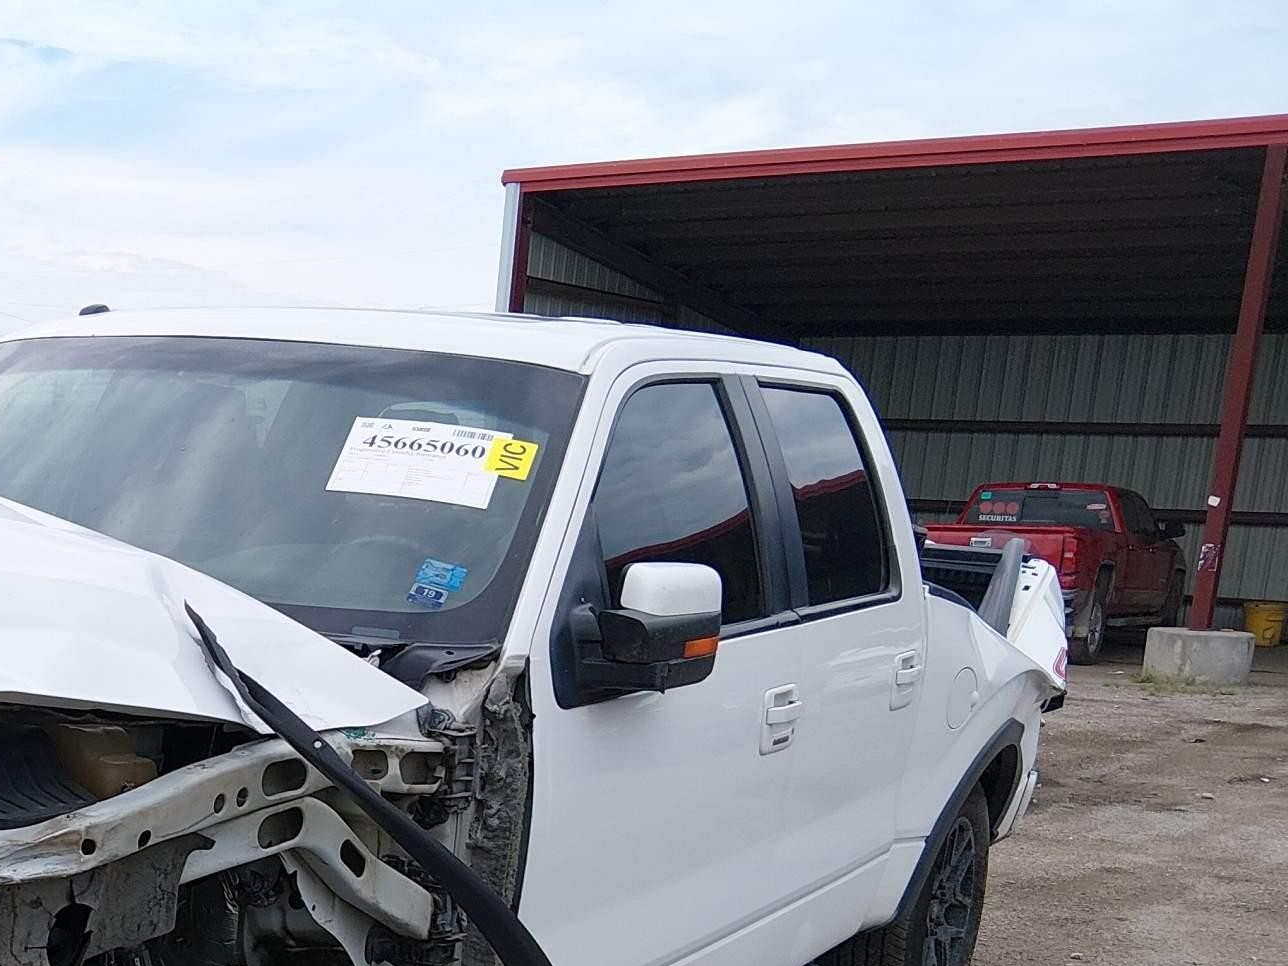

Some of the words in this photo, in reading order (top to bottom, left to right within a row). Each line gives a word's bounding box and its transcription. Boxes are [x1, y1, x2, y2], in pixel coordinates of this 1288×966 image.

[362, 434, 486, 460] 45665060
[495, 442, 527, 472] VIC
[978, 514, 1017, 522] SECURITAS
[423, 588, 436, 598] 19
